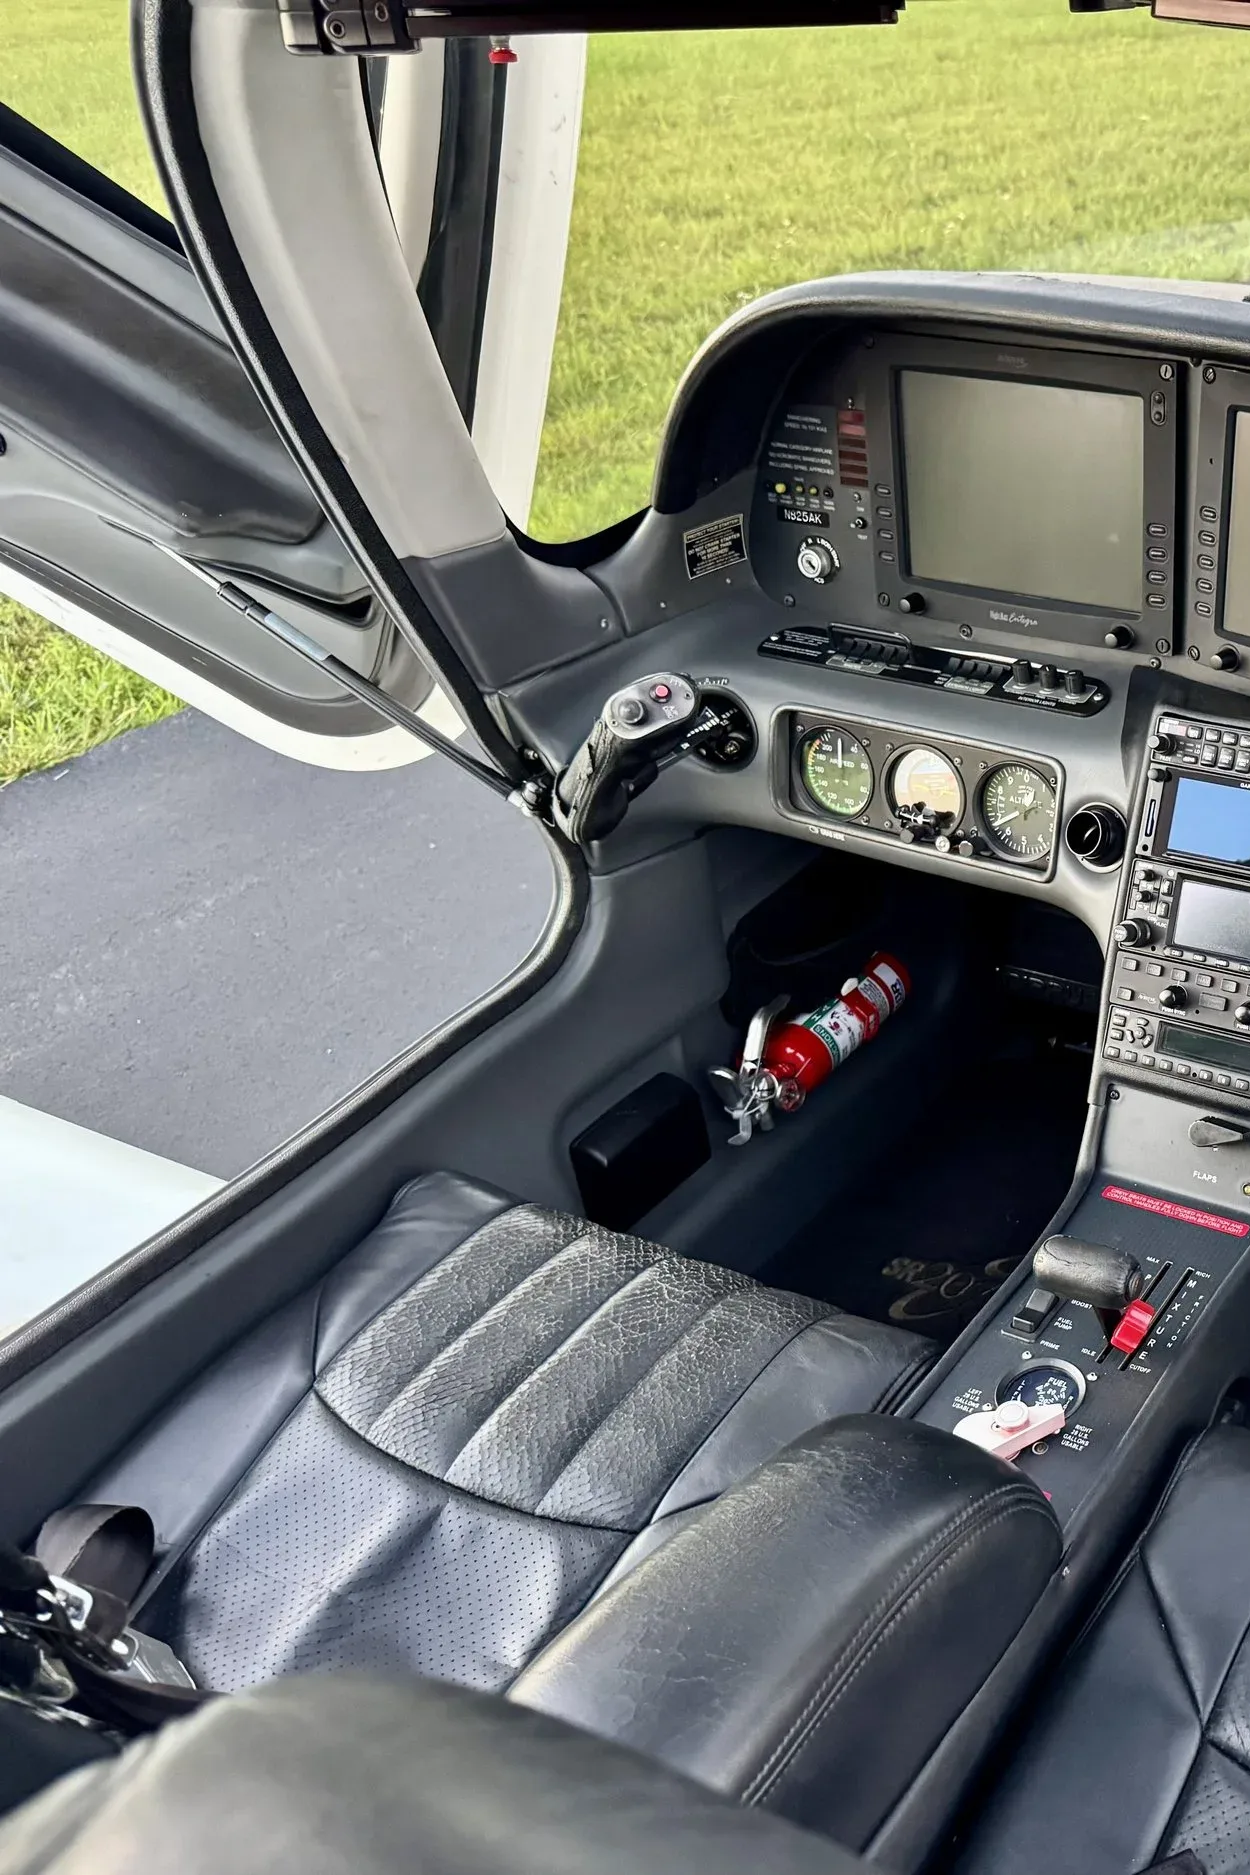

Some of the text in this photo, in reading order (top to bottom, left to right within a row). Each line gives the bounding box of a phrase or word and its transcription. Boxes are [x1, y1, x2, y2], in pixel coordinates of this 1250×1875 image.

[822, 744, 832, 752] 200
[816, 753, 826, 761] 180
[1007, 776, 1014, 785] 9
[1024, 774, 1030, 783] 0
[997, 786, 1003, 795] 8
[1006, 827, 1012, 836] 6
[1021, 836, 1027, 845] 5
[1193, 1170, 1217, 1183] FLAPS
[1107, 1192, 1243, 1233] CONTROL HANDLES FULLY DOWN BEFORE FLIGHT
[1129, 1192, 1147, 1200] SEATS
[1147, 1197, 1164, 1205] MUST
[1172, 1204, 1195, 1216] LOCKED
[1203, 1213, 1230, 1226] POSITION
[1231, 1222, 1244, 1230] AND
[1146, 1256, 1160, 1264] MAX
[1195, 1271, 1211, 1279] RICH
[1071, 1299, 1093, 1309] BOOST
[1058, 1317, 1073, 1326] FUEL
[1138, 1280, 1197, 1360] MIXTURE
[1167, 1295, 1204, 1348] FRICTION
[1054, 1322, 1073, 1330] PUMP
[1040, 1340, 1060, 1350] PRIME
[1081, 1347, 1097, 1357] IDLE
[1129, 1363, 1152, 1374] CUTOFF
[1048, 1377, 1067, 1389] FUEL
[968, 1387, 982, 1396] LEFT
[952, 1402, 974, 1413] USABLE
[954, 1396, 980, 1409] GALLONS
[1074, 1424, 1093, 1434] RIGHT
[1061, 1440, 1085, 1451] USABLE
[1063, 1434, 1090, 1447] GALLONS
